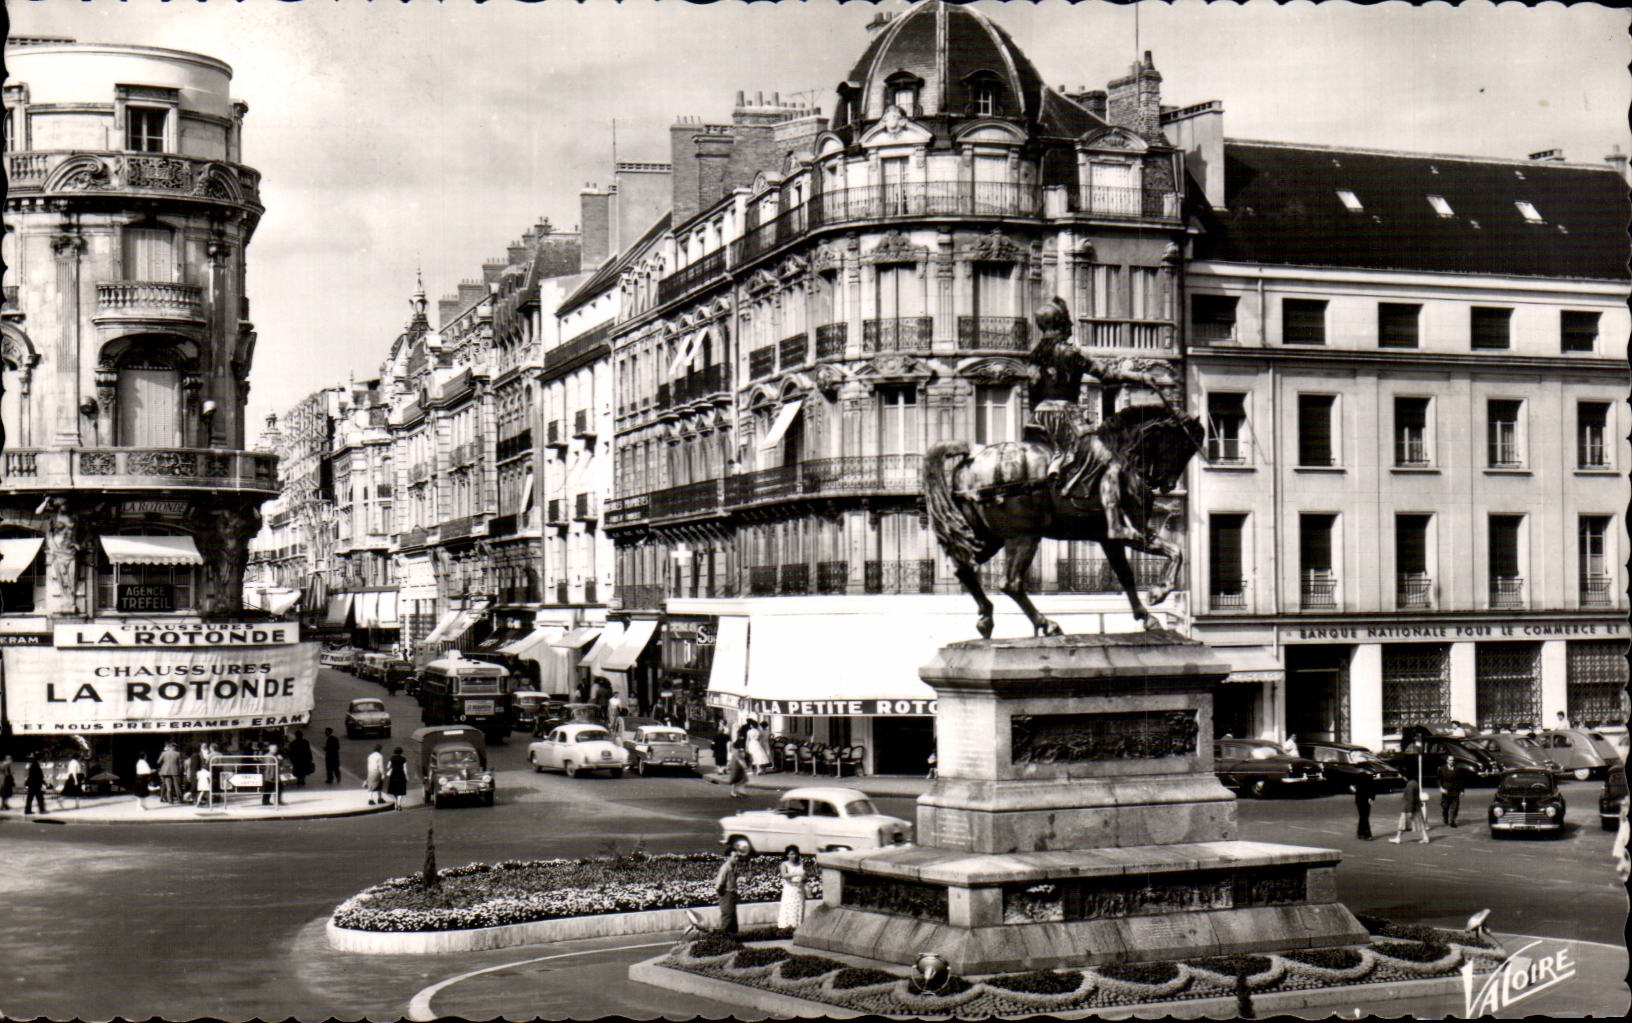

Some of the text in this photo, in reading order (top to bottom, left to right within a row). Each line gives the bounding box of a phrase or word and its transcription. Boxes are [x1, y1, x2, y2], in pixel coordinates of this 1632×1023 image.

[125, 586, 166, 597] AGENCE
[121, 623, 254, 631] CHAUSSURES
[1300, 624, 1621, 640] BANQUE NATIONALE POUR LE COMMERCE ET
[76, 629, 285, 644] LA ROTONDE
[94, 663, 272, 678] CHAUSSURES
[46, 677, 295, 703] LA ROTONDE
[761, 701, 782, 715] LA
[788, 701, 864, 715] PETITE
[54, 723, 104, 731] NOUS
